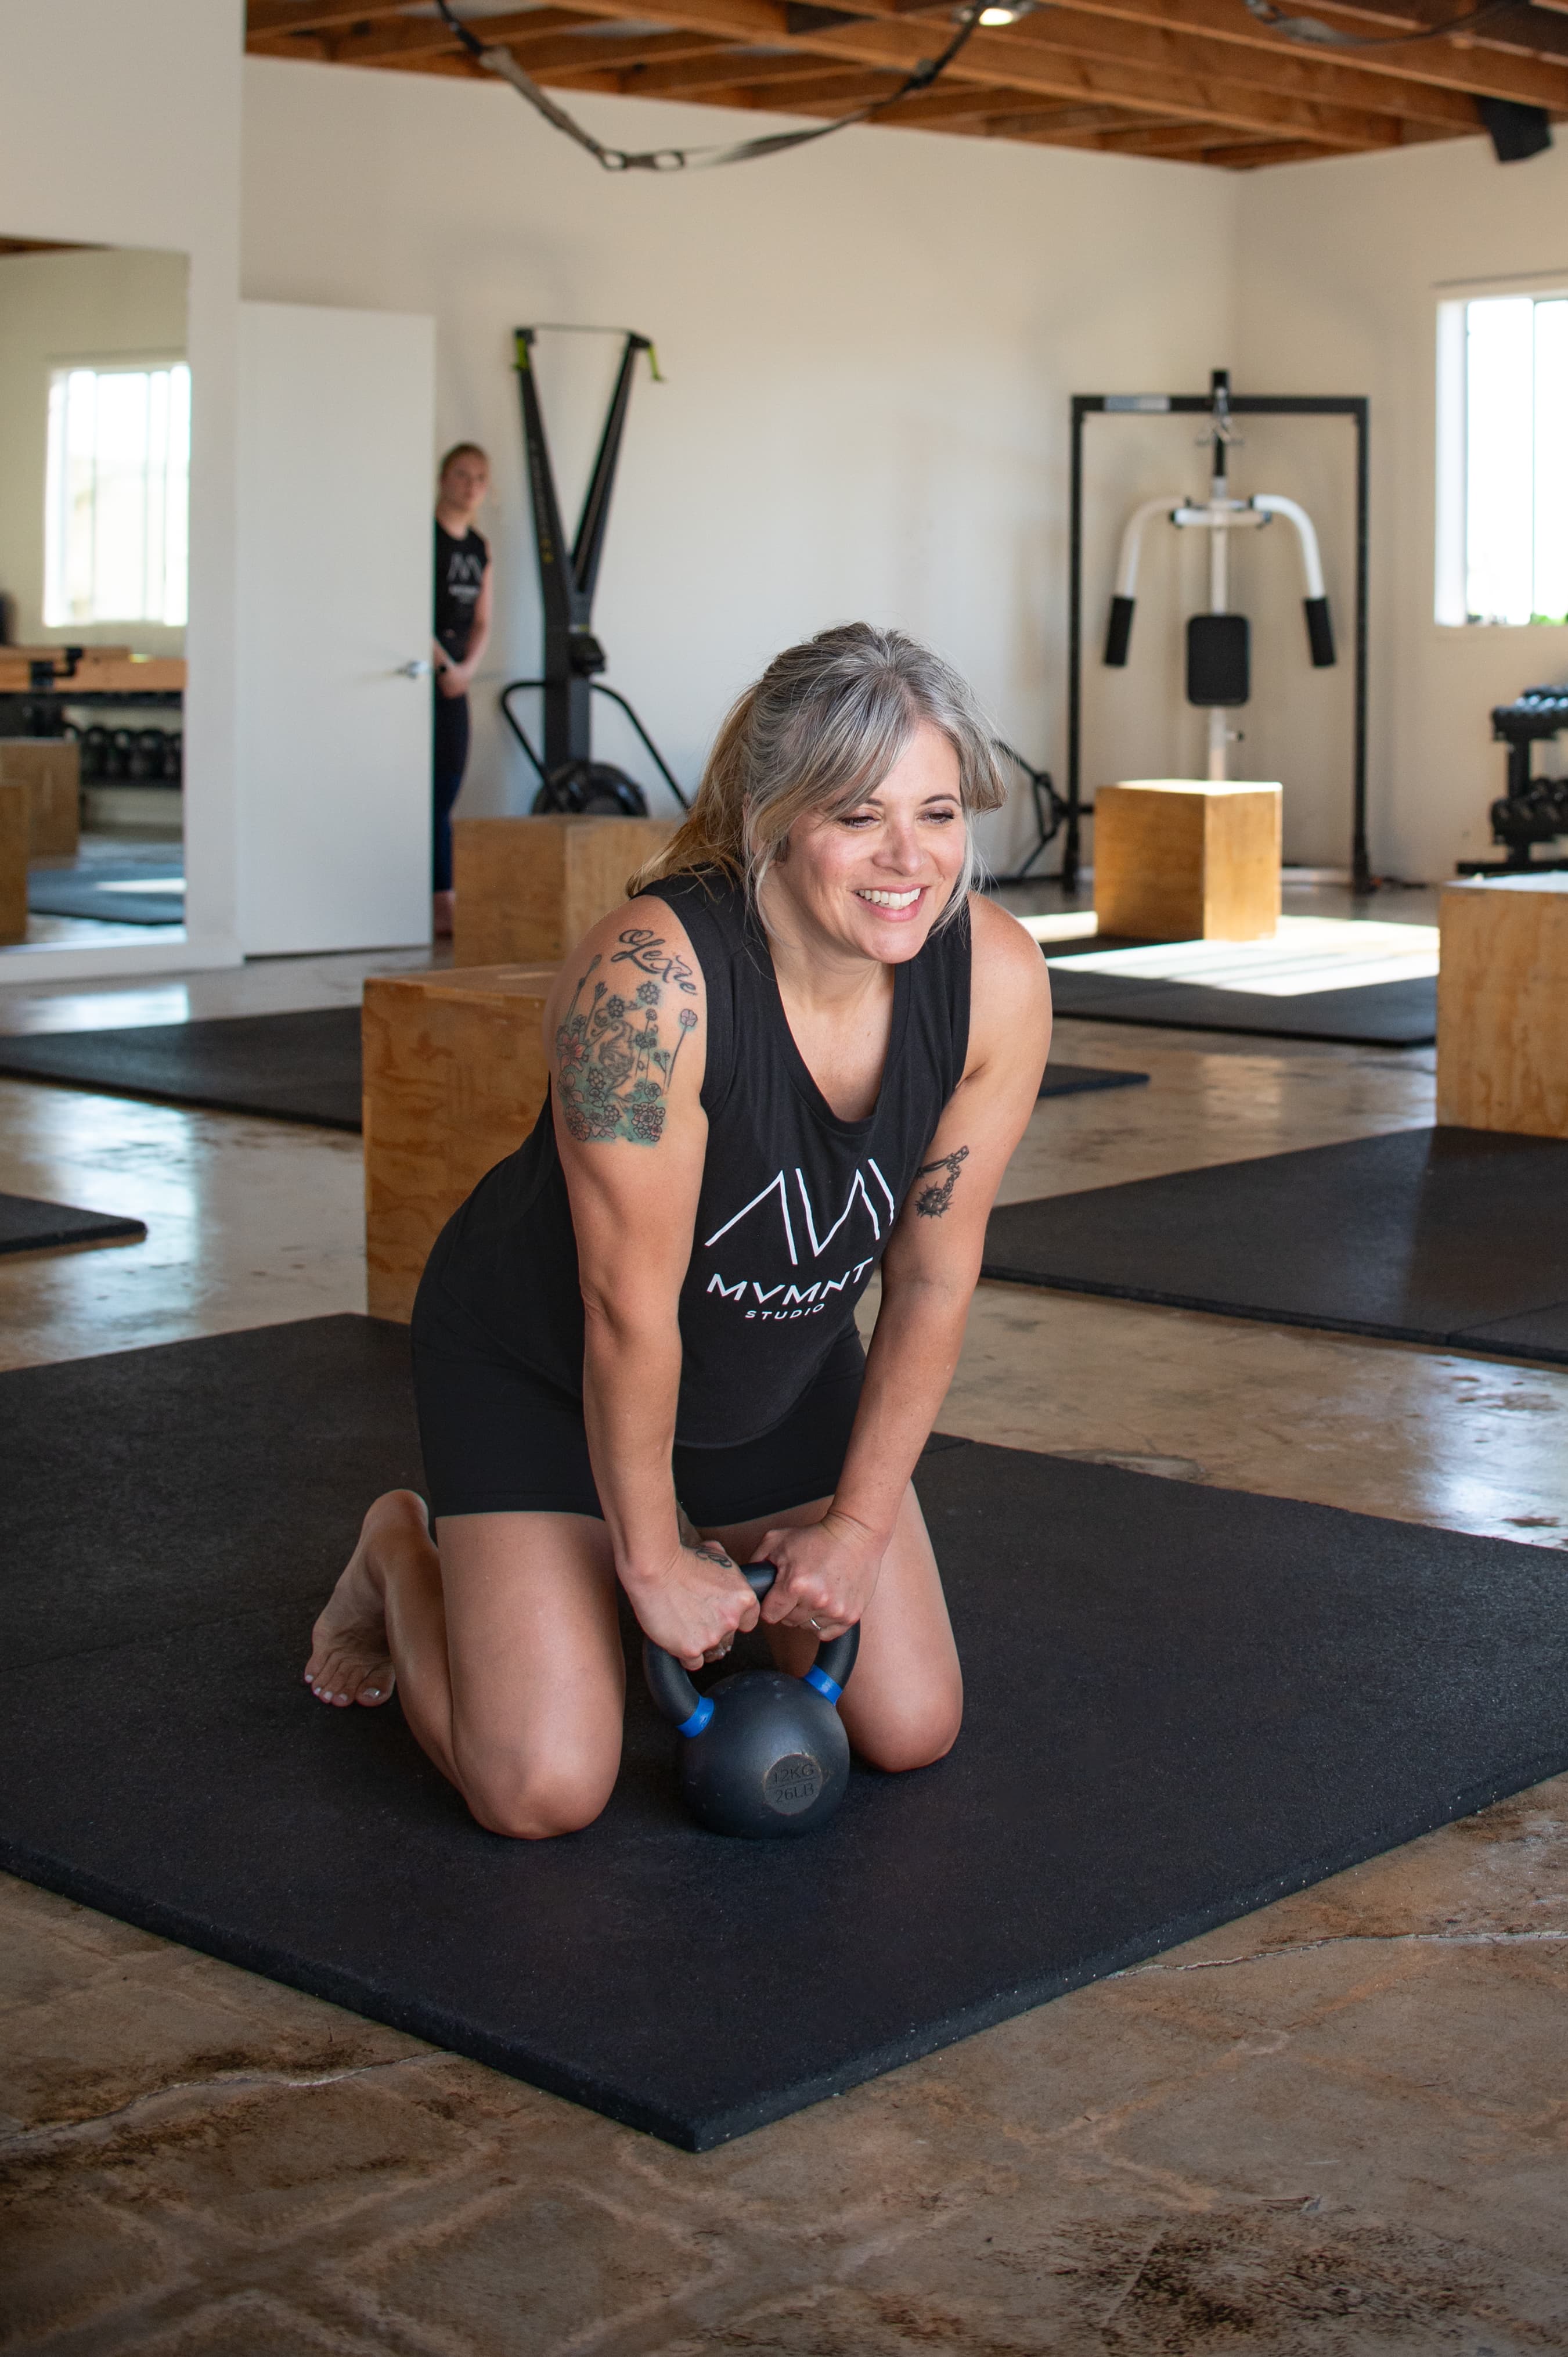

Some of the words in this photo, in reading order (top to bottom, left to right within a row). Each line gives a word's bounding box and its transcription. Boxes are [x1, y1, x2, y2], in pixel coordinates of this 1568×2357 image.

[706, 1257, 873, 1305] MVMNT
[745, 1304, 825, 1320] STUDIO
[774, 1764, 814, 1784] 12KG
[775, 1783, 814, 1803] 26LB
